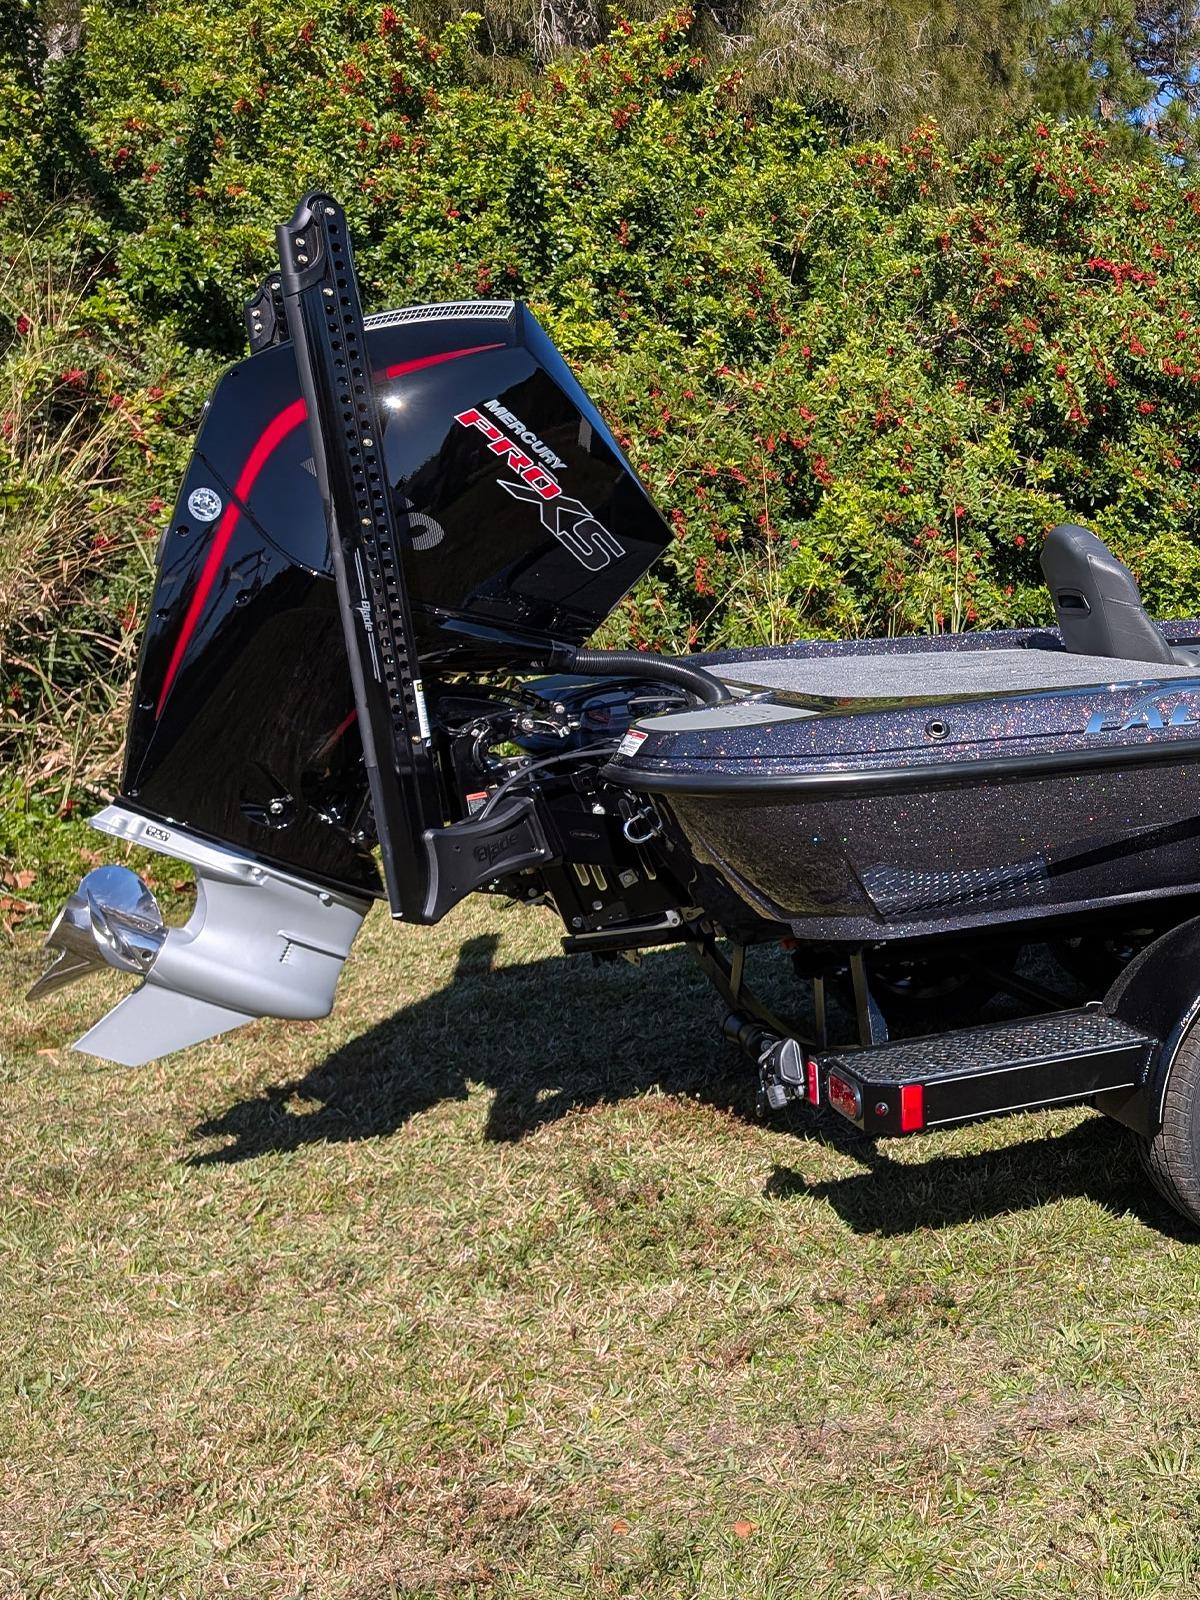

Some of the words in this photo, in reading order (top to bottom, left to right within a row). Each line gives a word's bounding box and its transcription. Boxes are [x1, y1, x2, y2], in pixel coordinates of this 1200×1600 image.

[454, 408, 562, 500] PRO
[483, 399, 568, 470] MERCURY
[496, 462, 626, 571] XS
[357, 599, 374, 633] Blade
